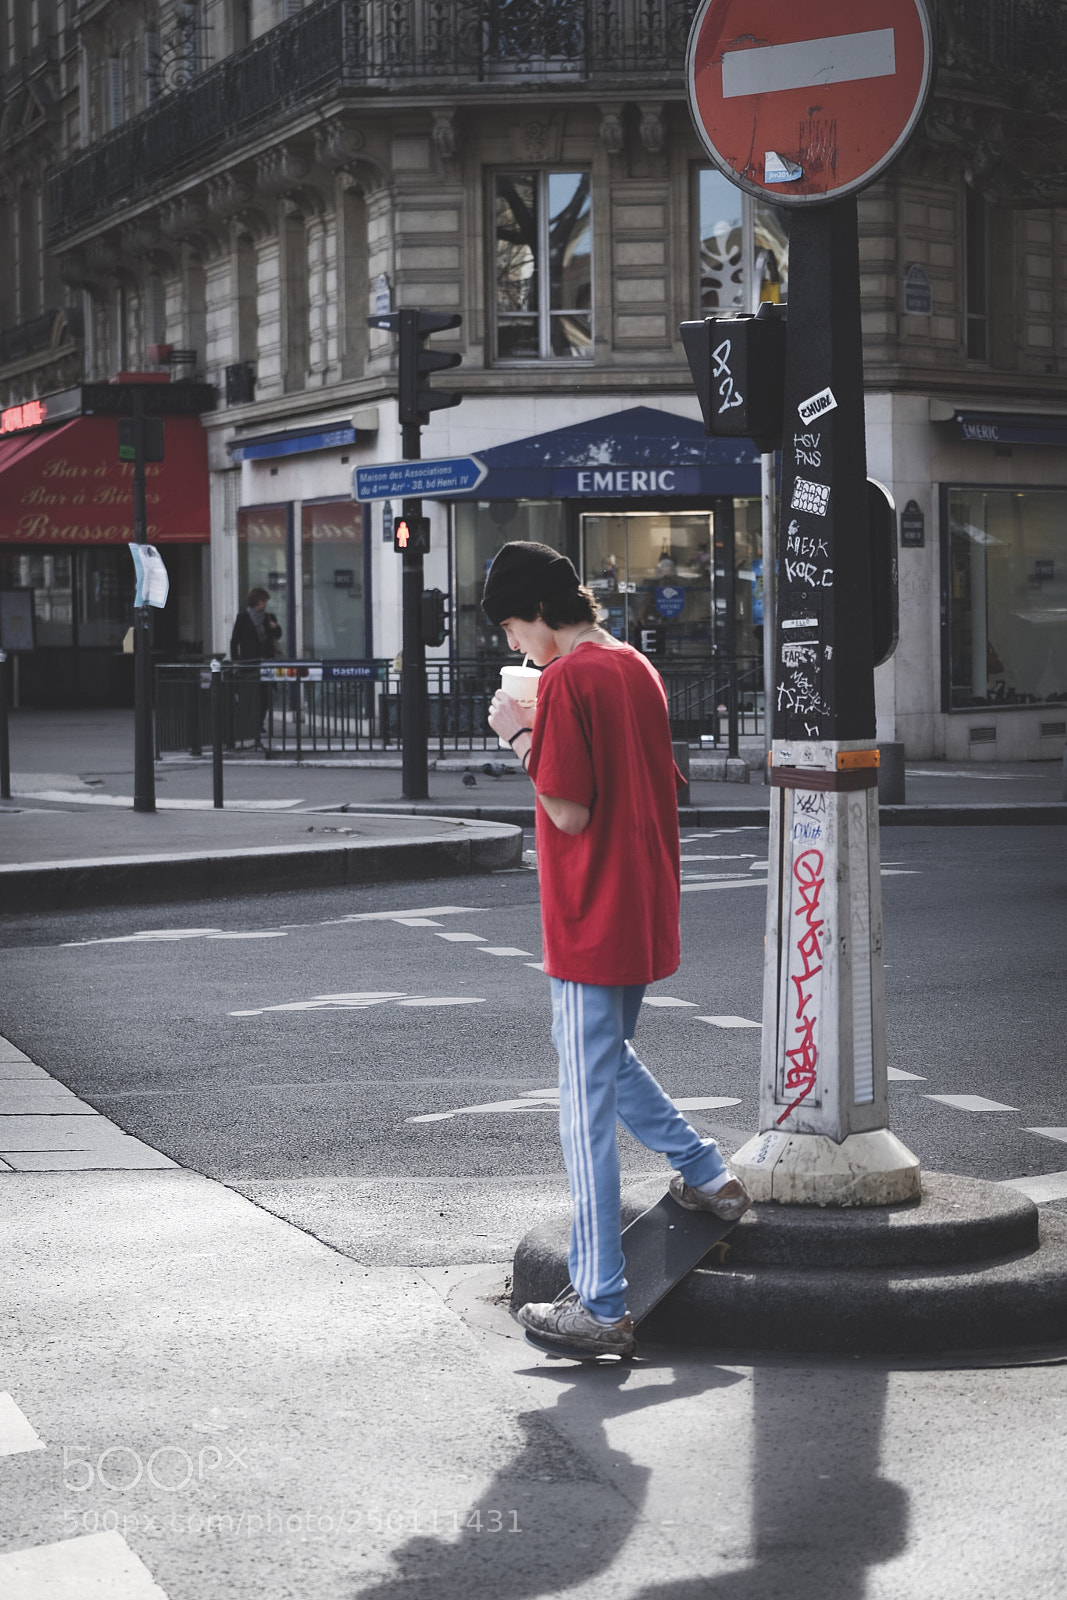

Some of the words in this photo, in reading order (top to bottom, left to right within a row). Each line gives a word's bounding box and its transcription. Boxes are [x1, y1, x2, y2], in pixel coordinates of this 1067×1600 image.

[963, 424, 1000, 440] EMERIC
[43, 458, 88, 477] Bar
[360, 472, 387, 482] Maison
[389, 471, 402, 480] des
[404, 467, 452, 478] Associations
[361, 486, 372, 495] du
[426, 480, 435, 489] bd
[436, 478, 457, 487] Henri
[460, 475, 469, 484] IV
[577, 470, 675, 491] EMERIC
[21, 486, 67, 505] Bar
[93, 486, 161, 505] Bièes
[15, 513, 161, 540] Brassere
[333, 667, 371, 676] Bastille
